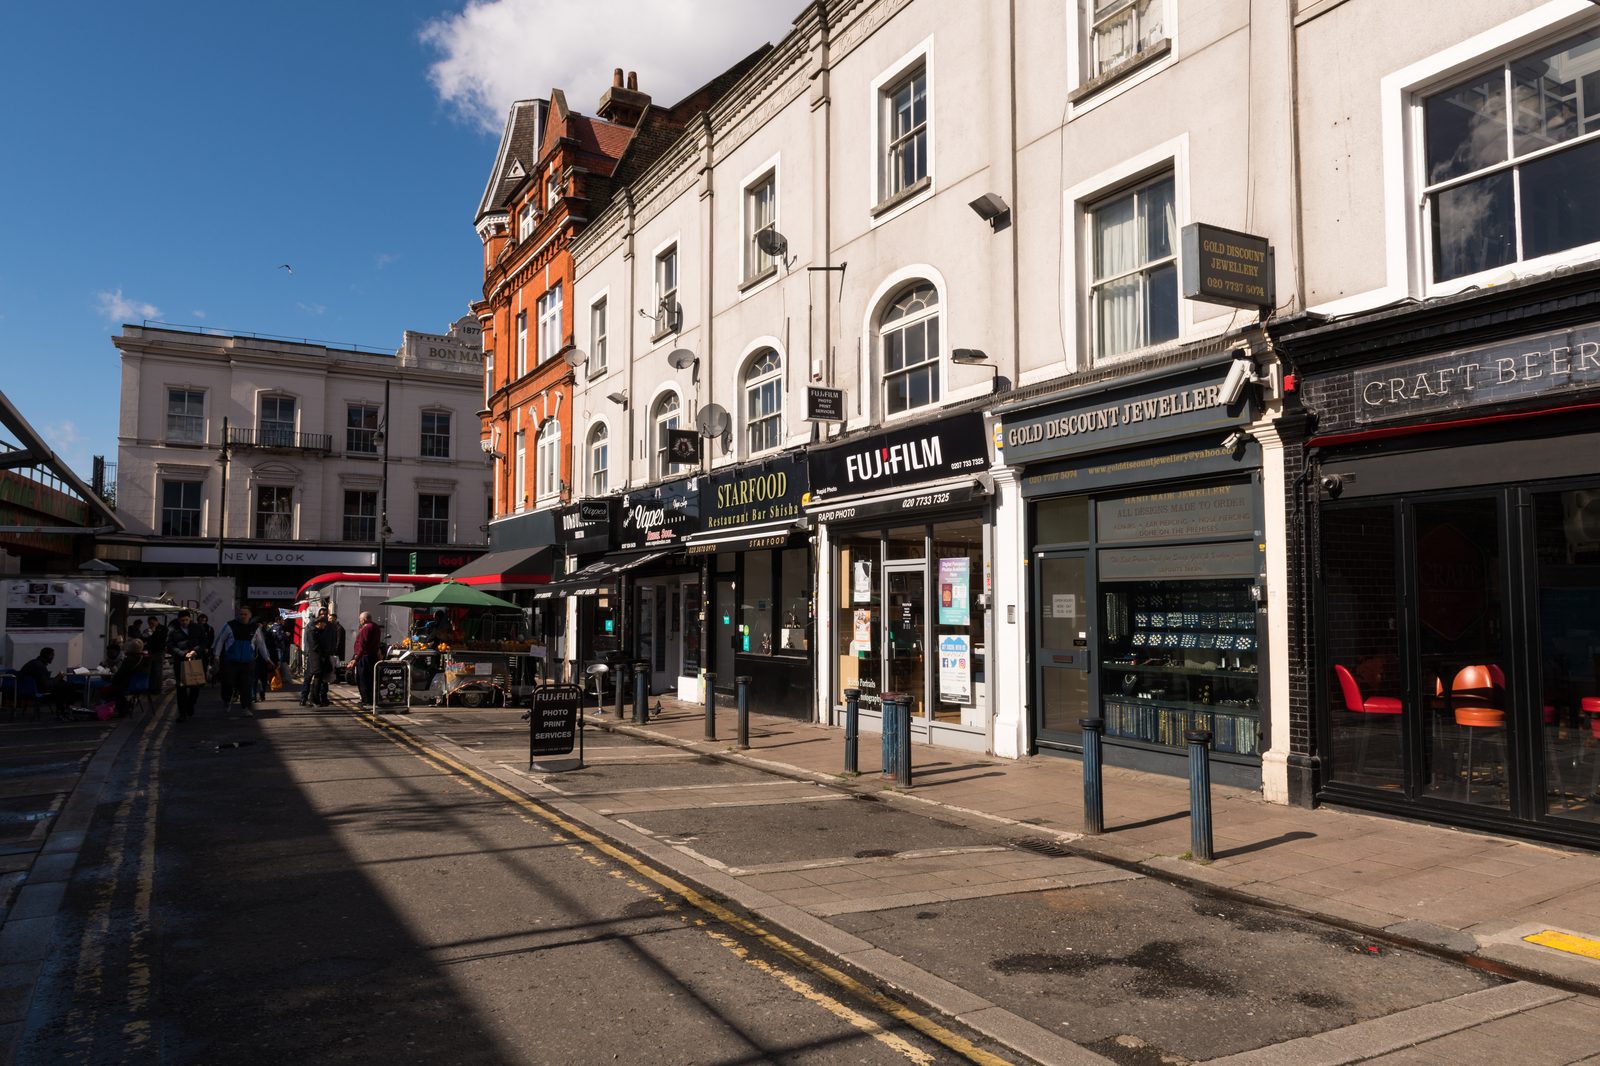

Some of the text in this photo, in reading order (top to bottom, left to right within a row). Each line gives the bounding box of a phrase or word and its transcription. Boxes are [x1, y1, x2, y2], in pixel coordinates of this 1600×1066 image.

[1203, 240, 1265, 263] GOLD DISCOUNT
[1211, 258, 1259, 277] JEWELLERY
[1207, 277, 1265, 297] 020 7737 5074
[463, 326, 481, 336] 1877
[430, 348, 456, 360] BON
[1363, 342, 1600, 405] CRAFT BEER
[811, 390, 839, 398] FUJIFILM
[1009, 384, 1226, 447] GOLD DISCOUNT JEWELLER
[846, 436, 942, 483] FUJIFILM
[951, 462, 962, 470] 0207
[963, 460, 972, 468] 733
[717, 471, 787, 509] STARFOOD
[902, 492, 950, 508] 020 7733 7325
[1116, 497, 1246, 518] ALL DESIGNS MADE TO ORDER
[583, 506, 607, 517] Vapes
[635, 504, 665, 534] Vapes
[708, 502, 799, 529] Restaurant Bar Shisha
[818, 508, 856, 522] RAPID PHOTO
[224, 552, 305, 562] NEW LOOK
[536, 692, 577, 701] FUJIFILM
[542, 709, 569, 717] PHOTO
[543, 720, 567, 728] PRINT
[535, 731, 572, 740] SERVICES
